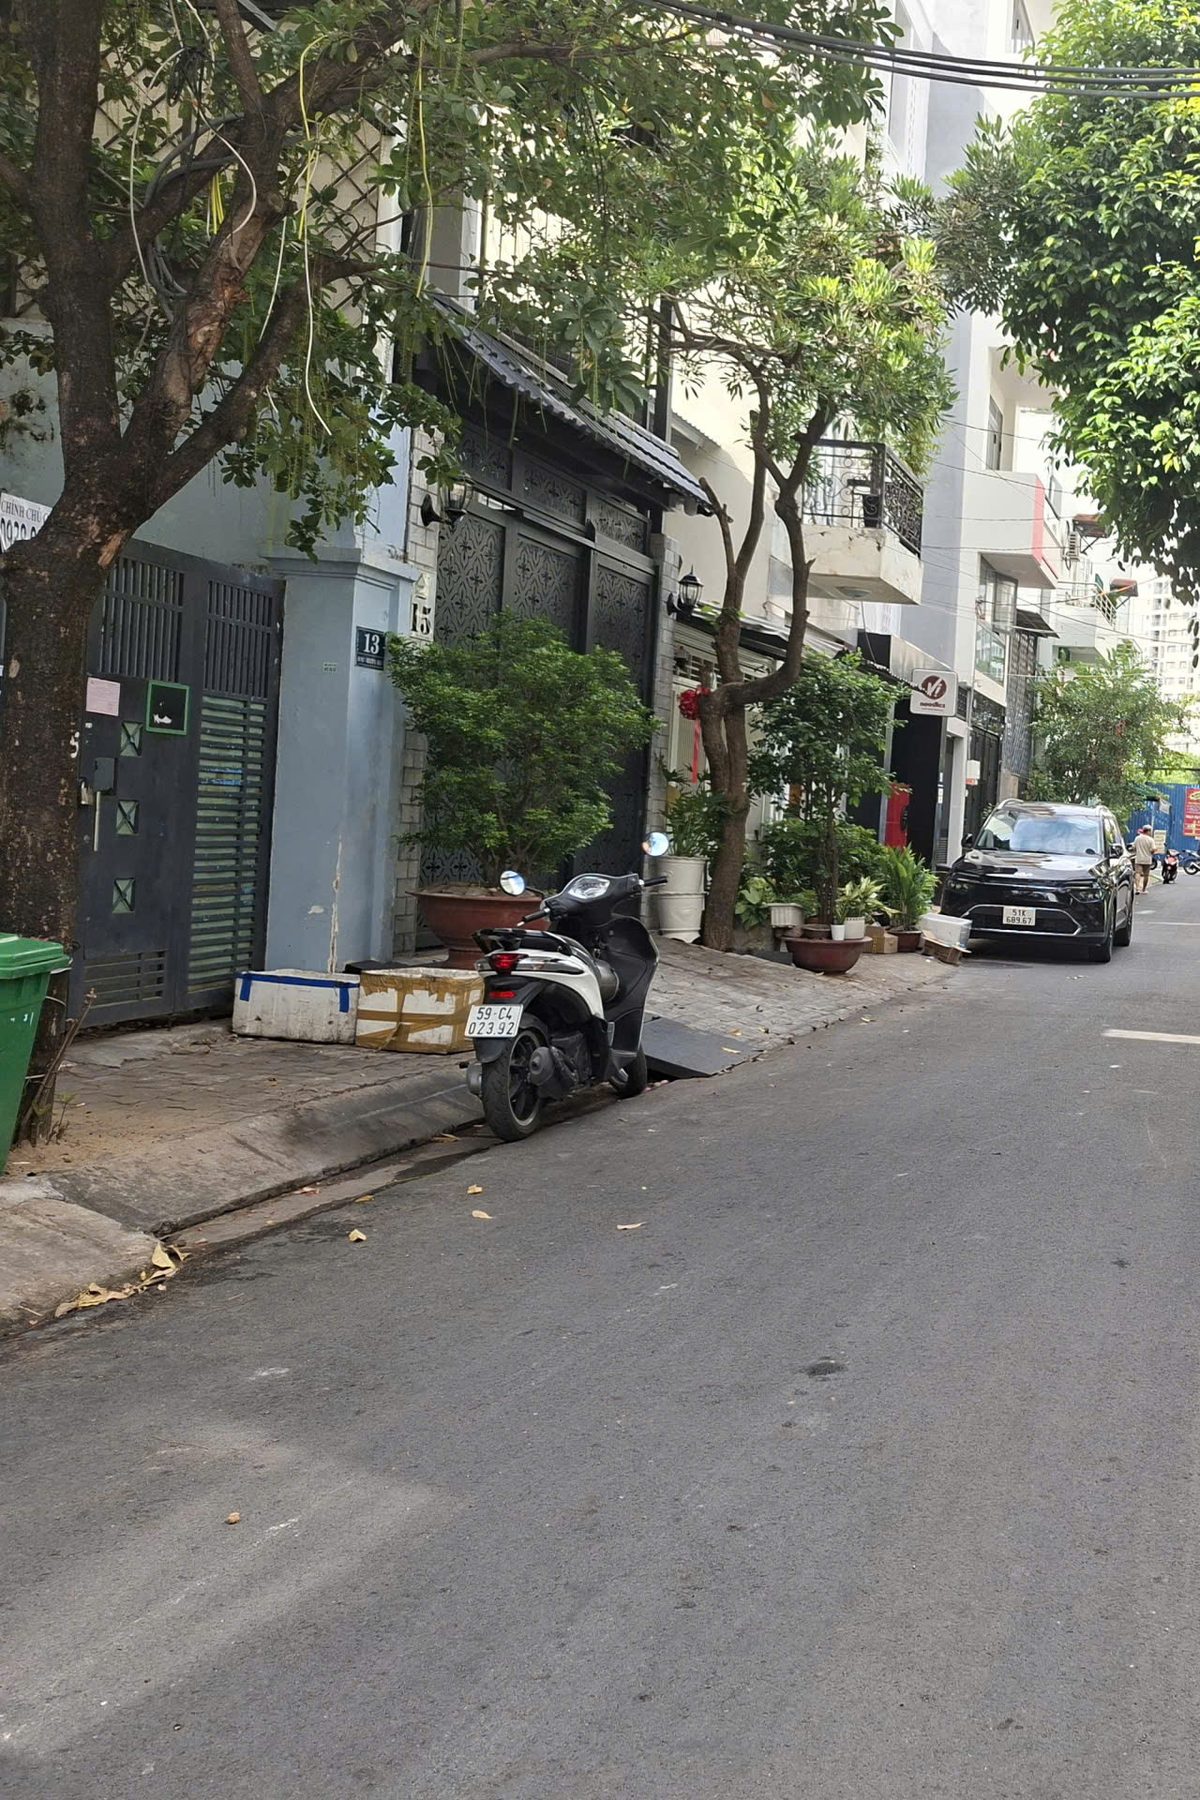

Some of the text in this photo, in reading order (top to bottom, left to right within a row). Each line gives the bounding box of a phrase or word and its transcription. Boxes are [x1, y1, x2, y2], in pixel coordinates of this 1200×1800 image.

[411, 603, 432, 635] 15
[364, 633, 380, 655] 13
[468, 1021, 515, 1035] 023.92
